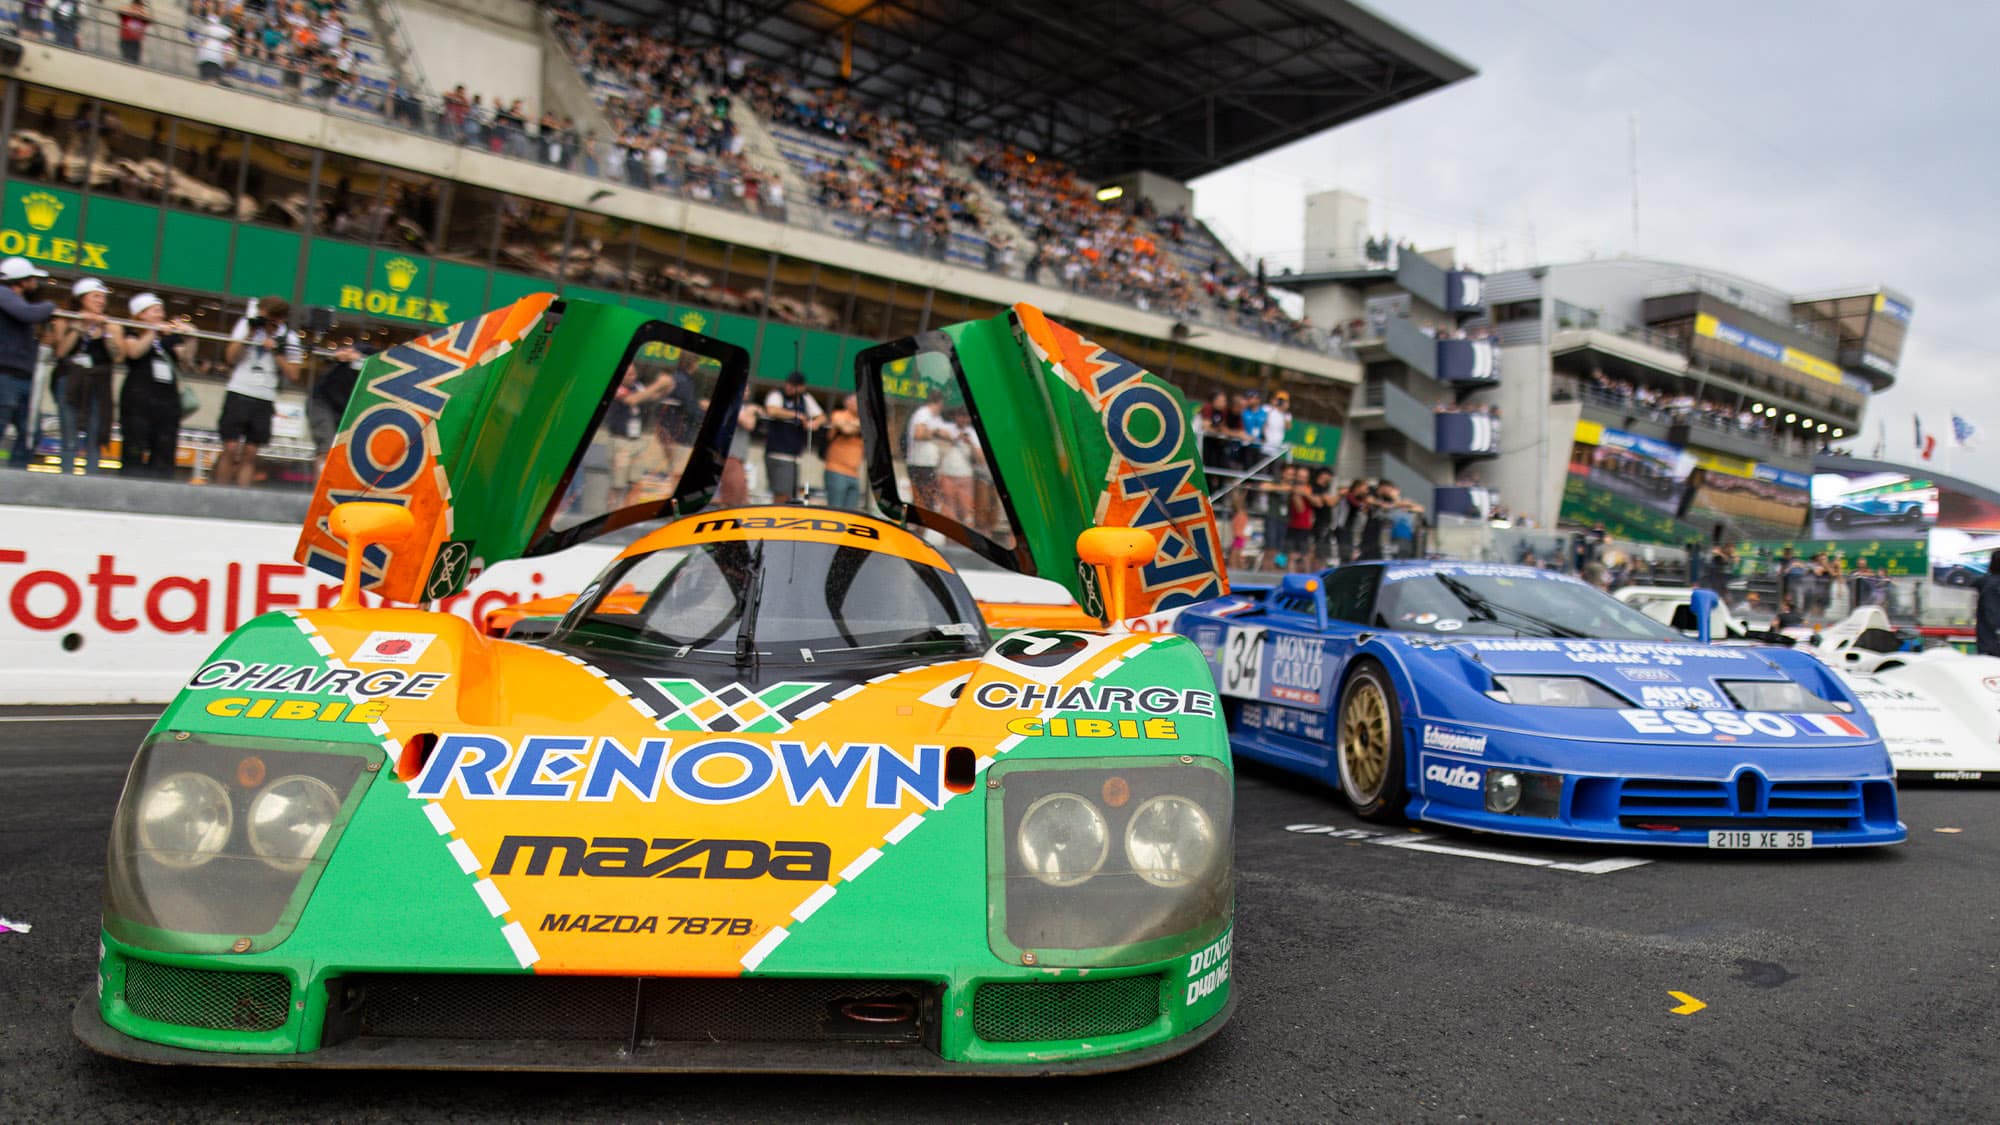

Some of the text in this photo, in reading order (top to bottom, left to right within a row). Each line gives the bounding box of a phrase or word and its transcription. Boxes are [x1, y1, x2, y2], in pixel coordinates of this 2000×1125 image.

[339, 285, 450, 325] ROLEX
[694, 516, 880, 541] mazda
[1228, 629, 1269, 692] 34
[1274, 635, 1326, 664] MONTE
[188, 660, 451, 701] CHARGE
[1272, 660, 1322, 690] CARLO
[975, 682, 1217, 718] CHARGE
[1640, 685, 1716, 702] AUTO
[205, 697, 390, 724] CIBIÉ
[1617, 709, 1797, 738] ESSO
[1007, 717, 1180, 741] CIBIÉ
[408, 734, 947, 811] RENOWN
[1426, 764, 1480, 788] auto
[1716, 832, 1805, 848] 2119 XE 35
[489, 835, 831, 881] mazda
[540, 914, 754, 937] MAZDA 787B
